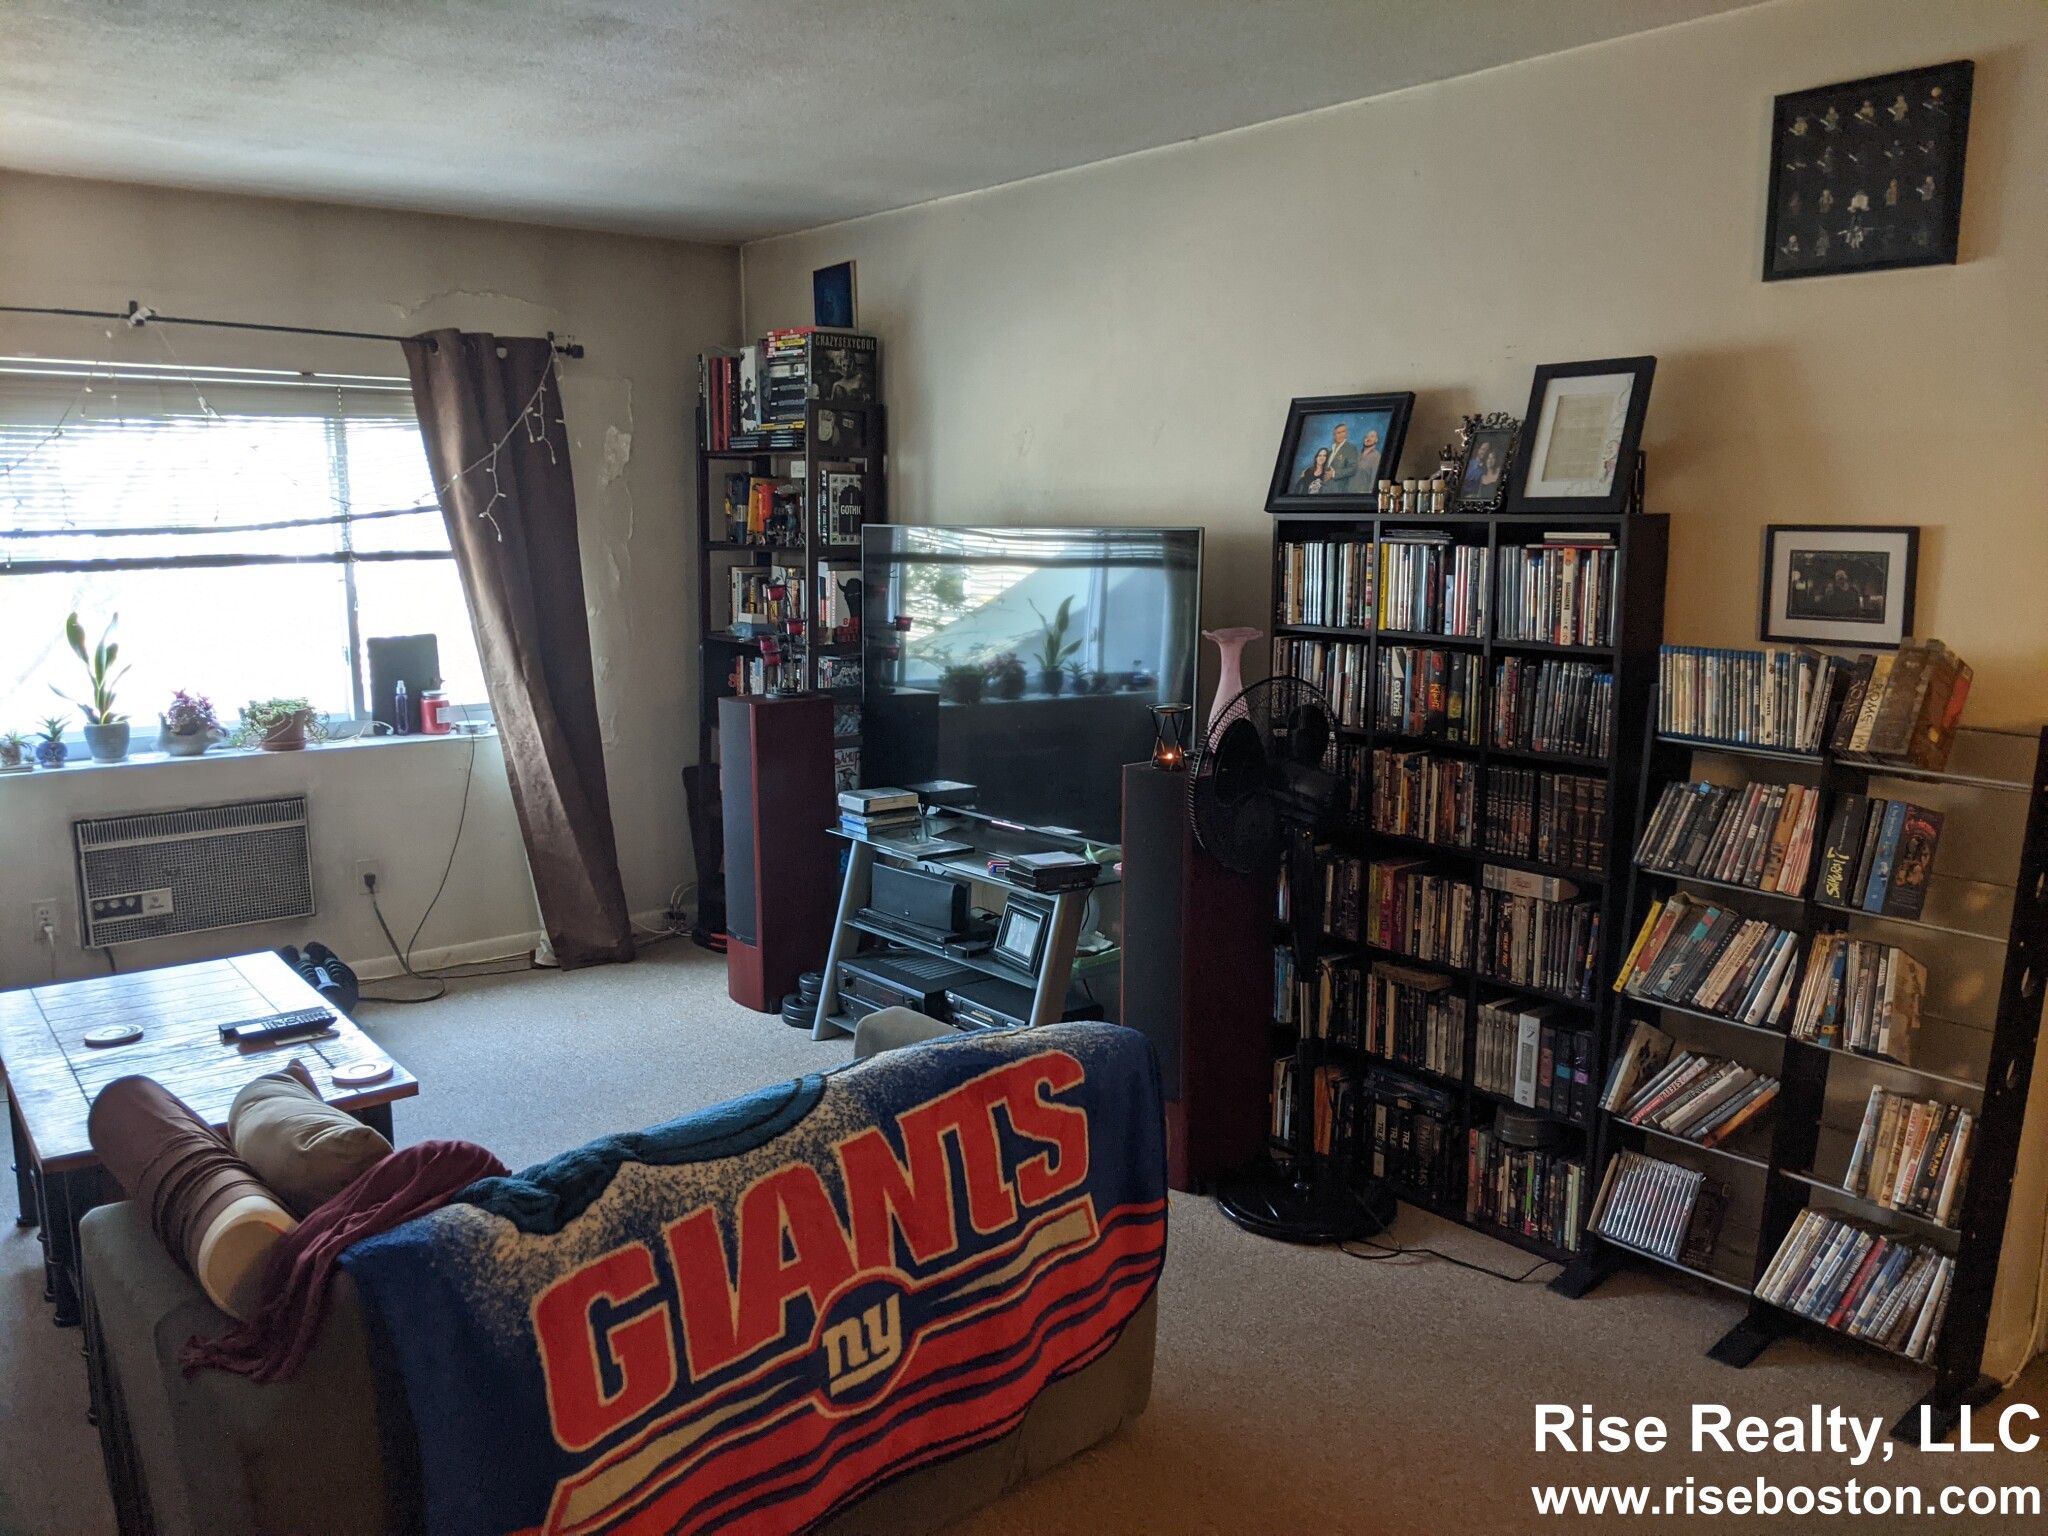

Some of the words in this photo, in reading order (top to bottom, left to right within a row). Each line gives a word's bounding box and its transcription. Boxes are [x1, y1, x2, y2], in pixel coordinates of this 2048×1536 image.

[815, 334, 875, 351] CRAZYSEXYCOOL
[1391, 680, 1402, 716] extras
[1860, 681, 1883, 723] ROME
[1927, 1131, 1949, 1177] HOMELAND
[530, 1050, 1090, 1452] GIANTS
